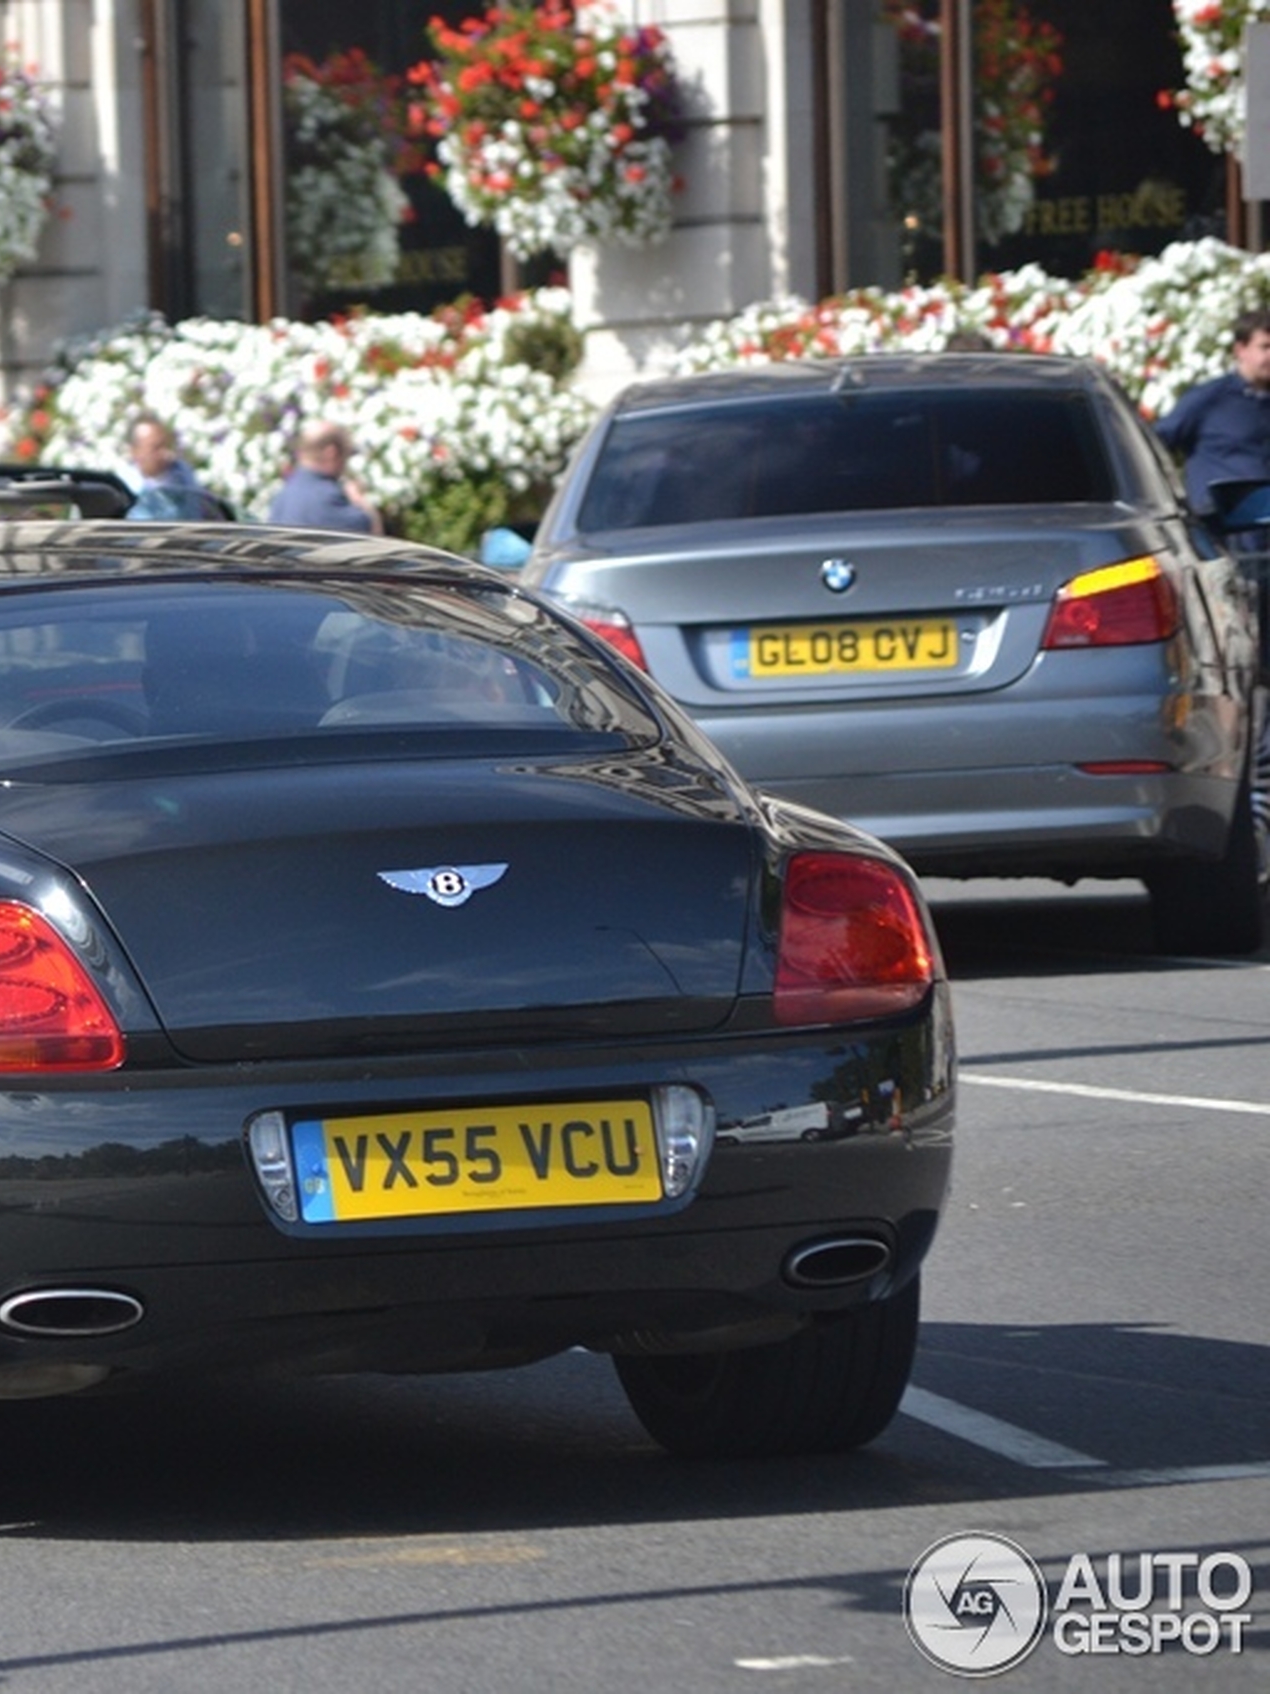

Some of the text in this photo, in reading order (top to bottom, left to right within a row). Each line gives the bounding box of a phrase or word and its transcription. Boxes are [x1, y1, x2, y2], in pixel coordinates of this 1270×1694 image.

[1025, 198, 1088, 236] FREE
[757, 626, 949, 666] GL08 CVJ
[434, 872, 464, 895] B
[333, 1119, 640, 1192] VX55 VCU
